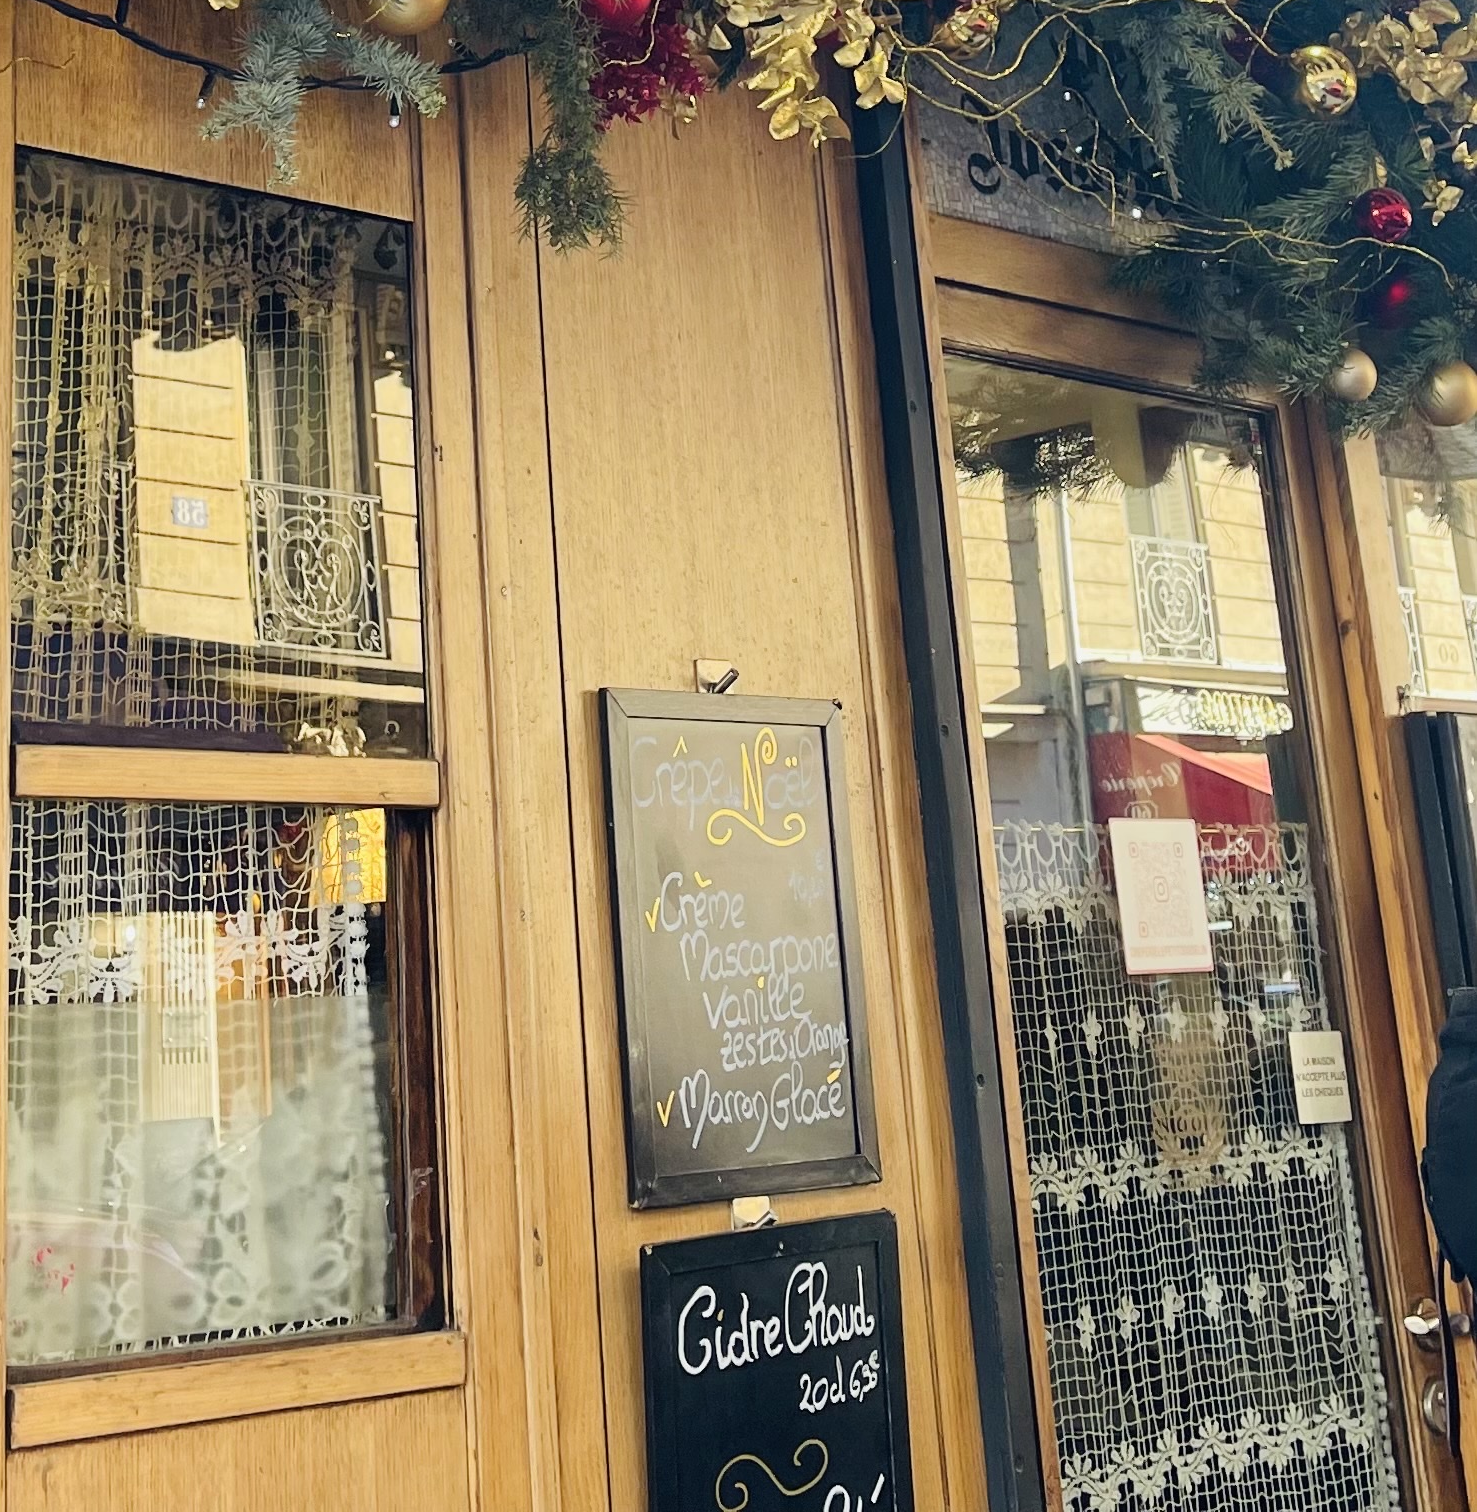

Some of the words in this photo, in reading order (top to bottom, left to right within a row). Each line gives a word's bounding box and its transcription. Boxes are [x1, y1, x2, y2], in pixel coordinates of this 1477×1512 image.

[632, 734, 724, 832] Crêpe
[740, 726, 816, 827] Noël
[660, 871, 746, 932] Crème
[679, 928, 840, 993] Mascarpone
[678, 1068, 769, 1154] Marron
[770, 1060, 847, 1131] Glacé
[677, 1285, 784, 1376] Cidre
[784, 1261, 876, 1355] Chaud
